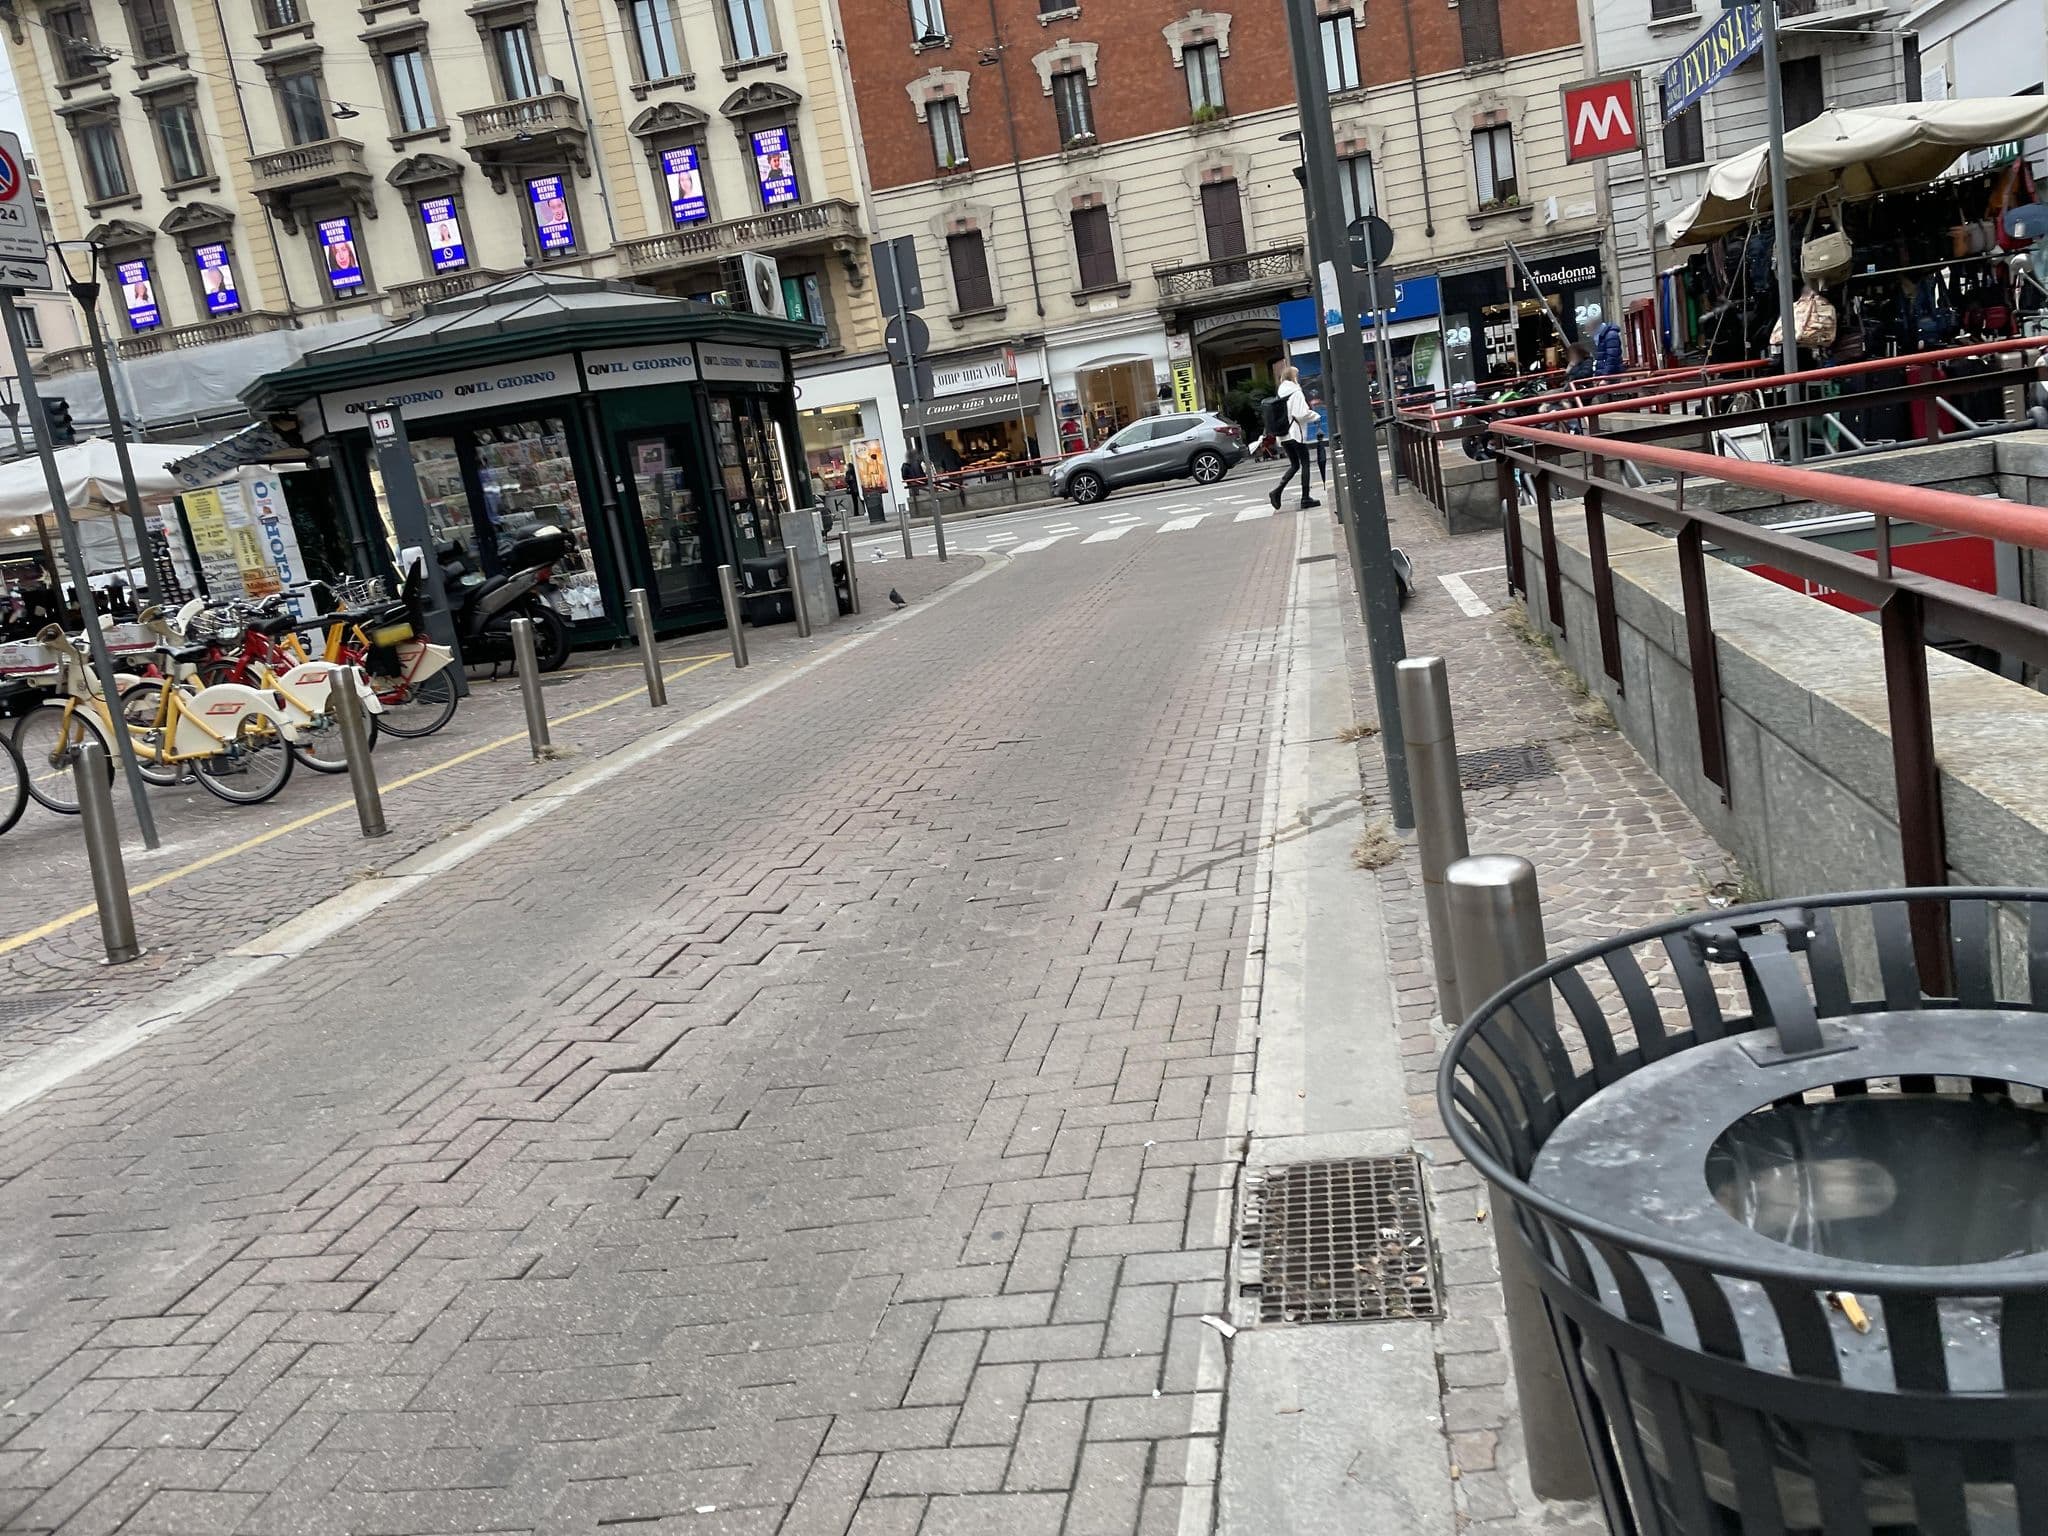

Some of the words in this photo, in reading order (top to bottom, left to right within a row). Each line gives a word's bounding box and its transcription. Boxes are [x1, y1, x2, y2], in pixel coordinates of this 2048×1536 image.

[1574, 96, 1632, 145] M
[1197, 314, 1237, 333] PIAZZA
[1241, 308, 1270, 320] LIMA
[632, 356, 692, 371] GIORNO
[938, 372, 960, 386] ome
[985, 362, 1005, 378] Volt
[497, 371, 556, 389] GIORNO
[387, 389, 443, 407] GIORNO
[926, 403, 960, 415] Come
[962, 397, 985, 409] una
[989, 392, 1019, 404] Volta
[376, 419, 390, 430] 113
[255, 481, 292, 583] GIORO
